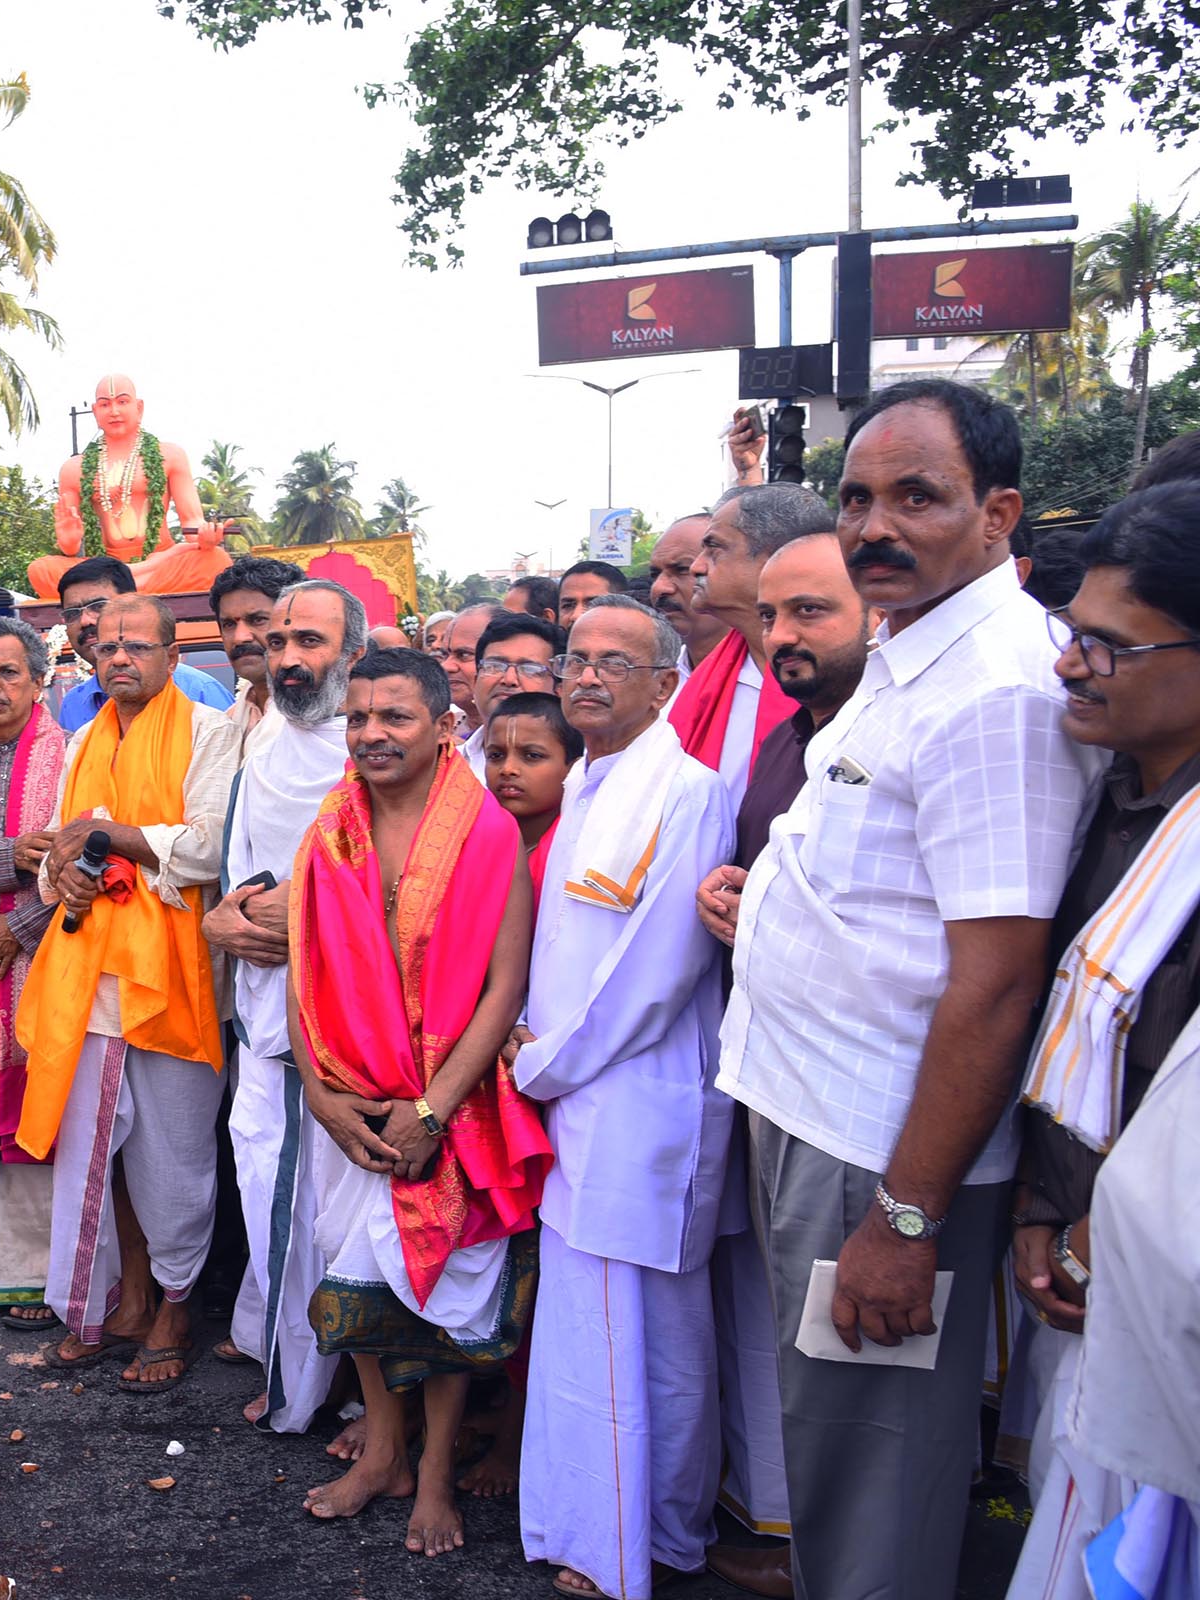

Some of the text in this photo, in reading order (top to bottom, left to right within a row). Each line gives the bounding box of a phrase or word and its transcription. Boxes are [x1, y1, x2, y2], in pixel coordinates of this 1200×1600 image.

[915, 304, 983, 320] KALYAN
[916, 319, 983, 328] JEWELLERS
[611, 326, 674, 343] KALYAN
[612, 340, 674, 350] JEWELLERS
